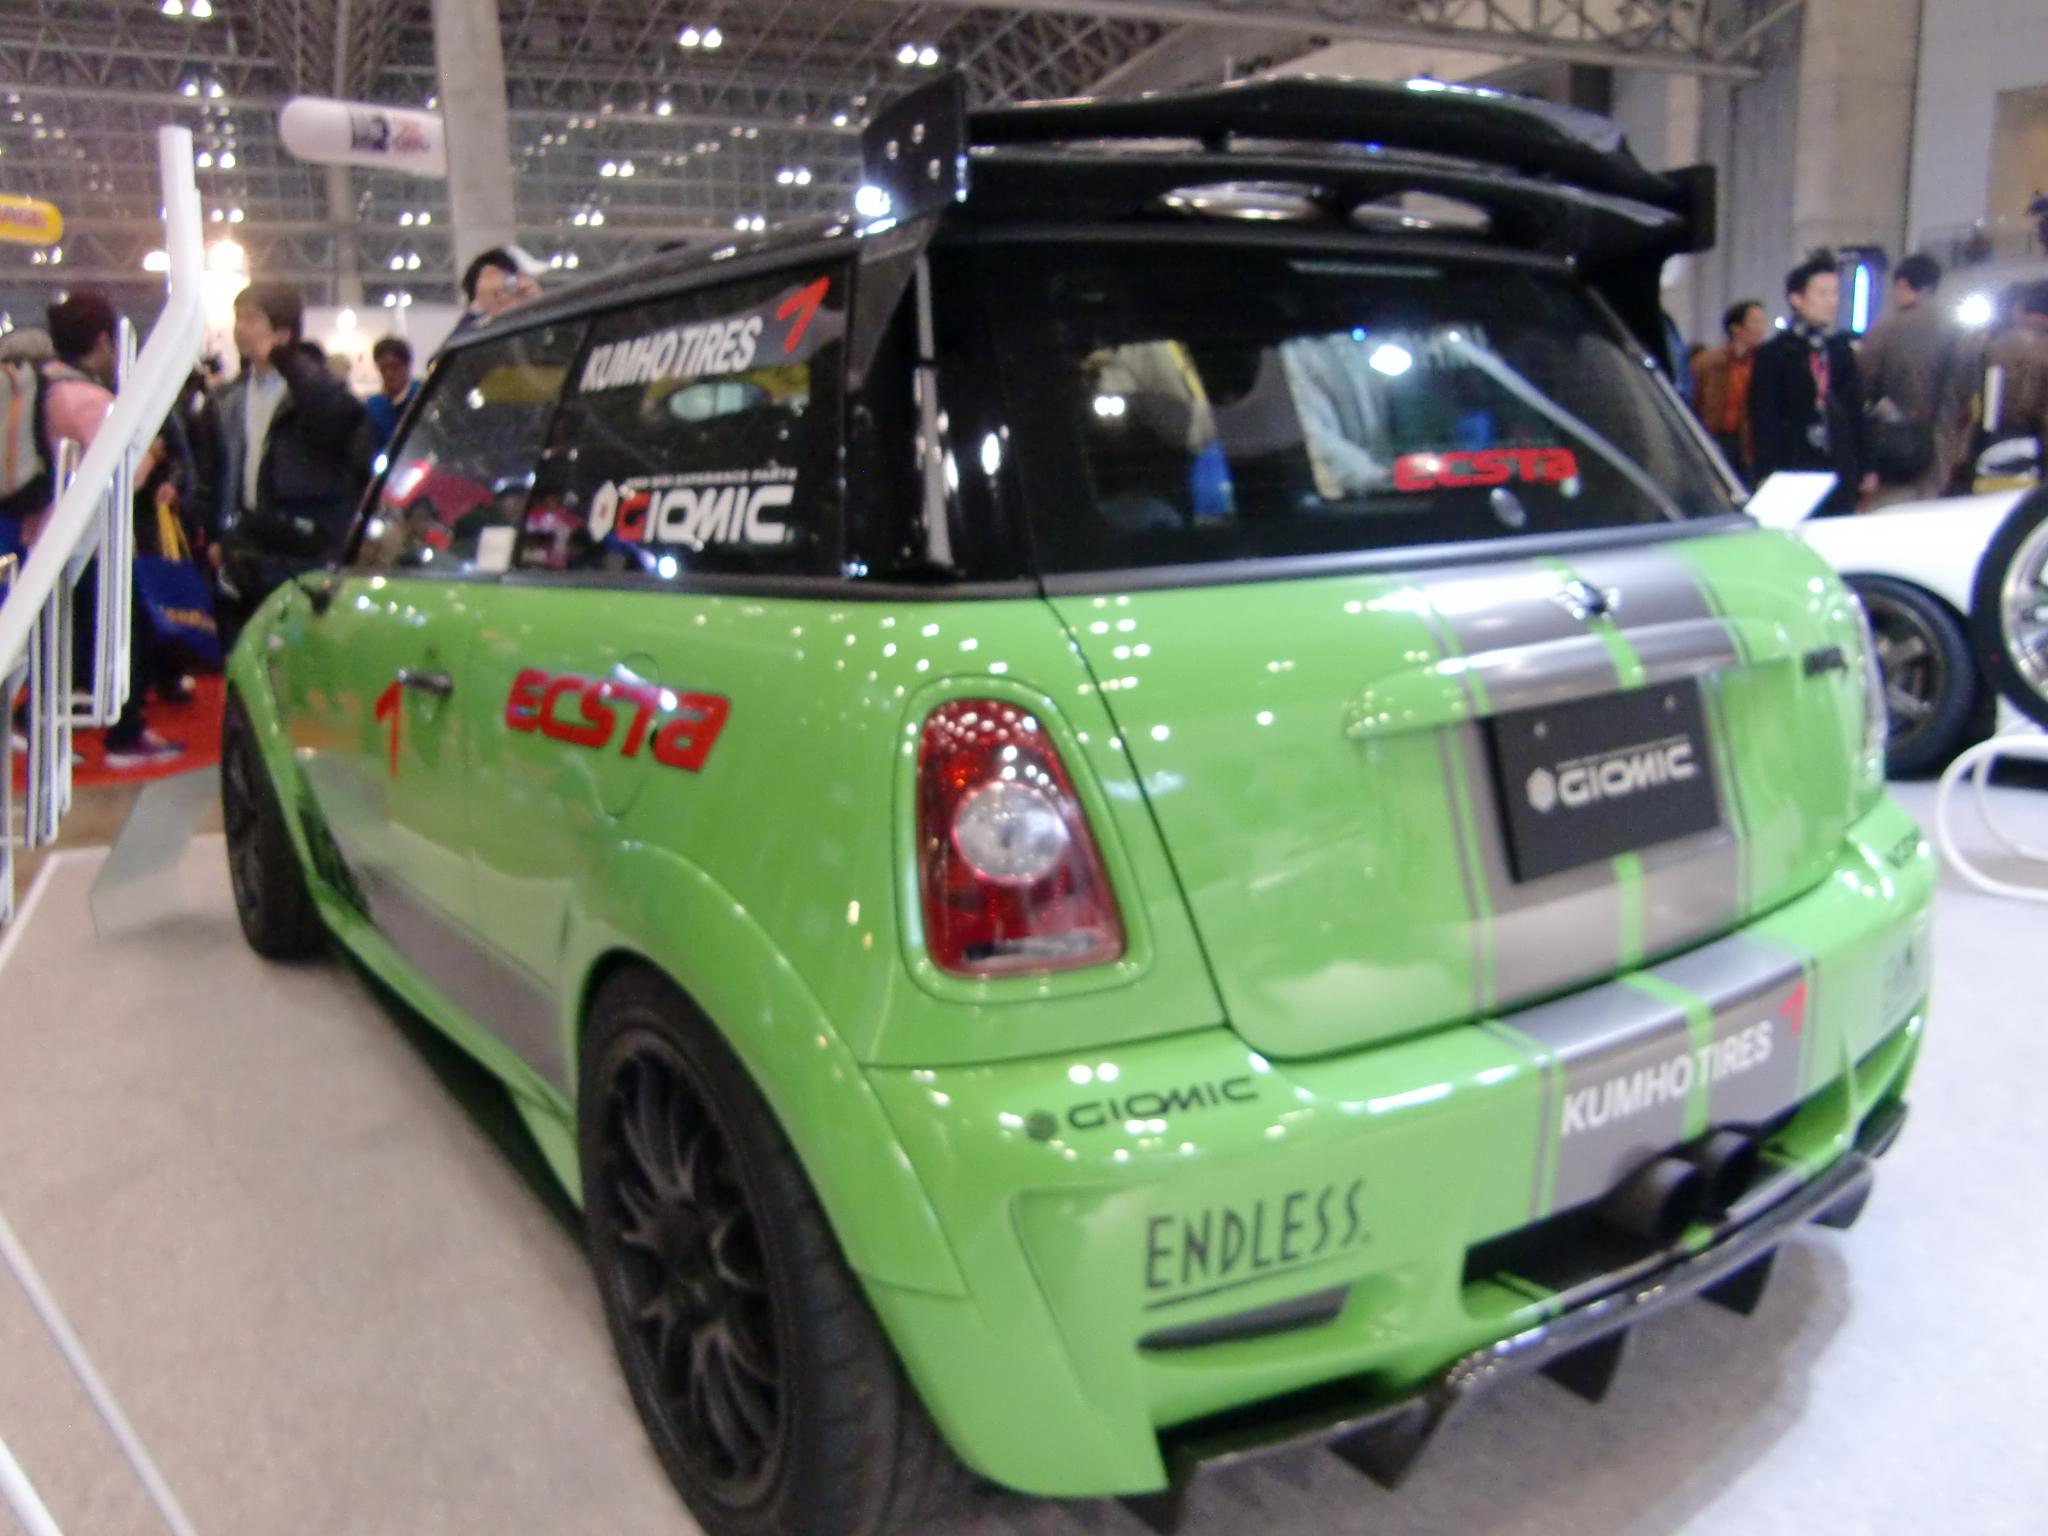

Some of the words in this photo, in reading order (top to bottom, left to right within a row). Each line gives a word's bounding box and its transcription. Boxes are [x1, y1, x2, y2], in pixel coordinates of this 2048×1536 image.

[614, 484, 795, 545] GIOMIC
[1557, 742, 1698, 808] GIOMIC
[1066, 1075, 1260, 1130] GIOMIC
[1561, 1054, 1693, 1136] KUMHO
[1696, 1019, 1774, 1086] TIRES
